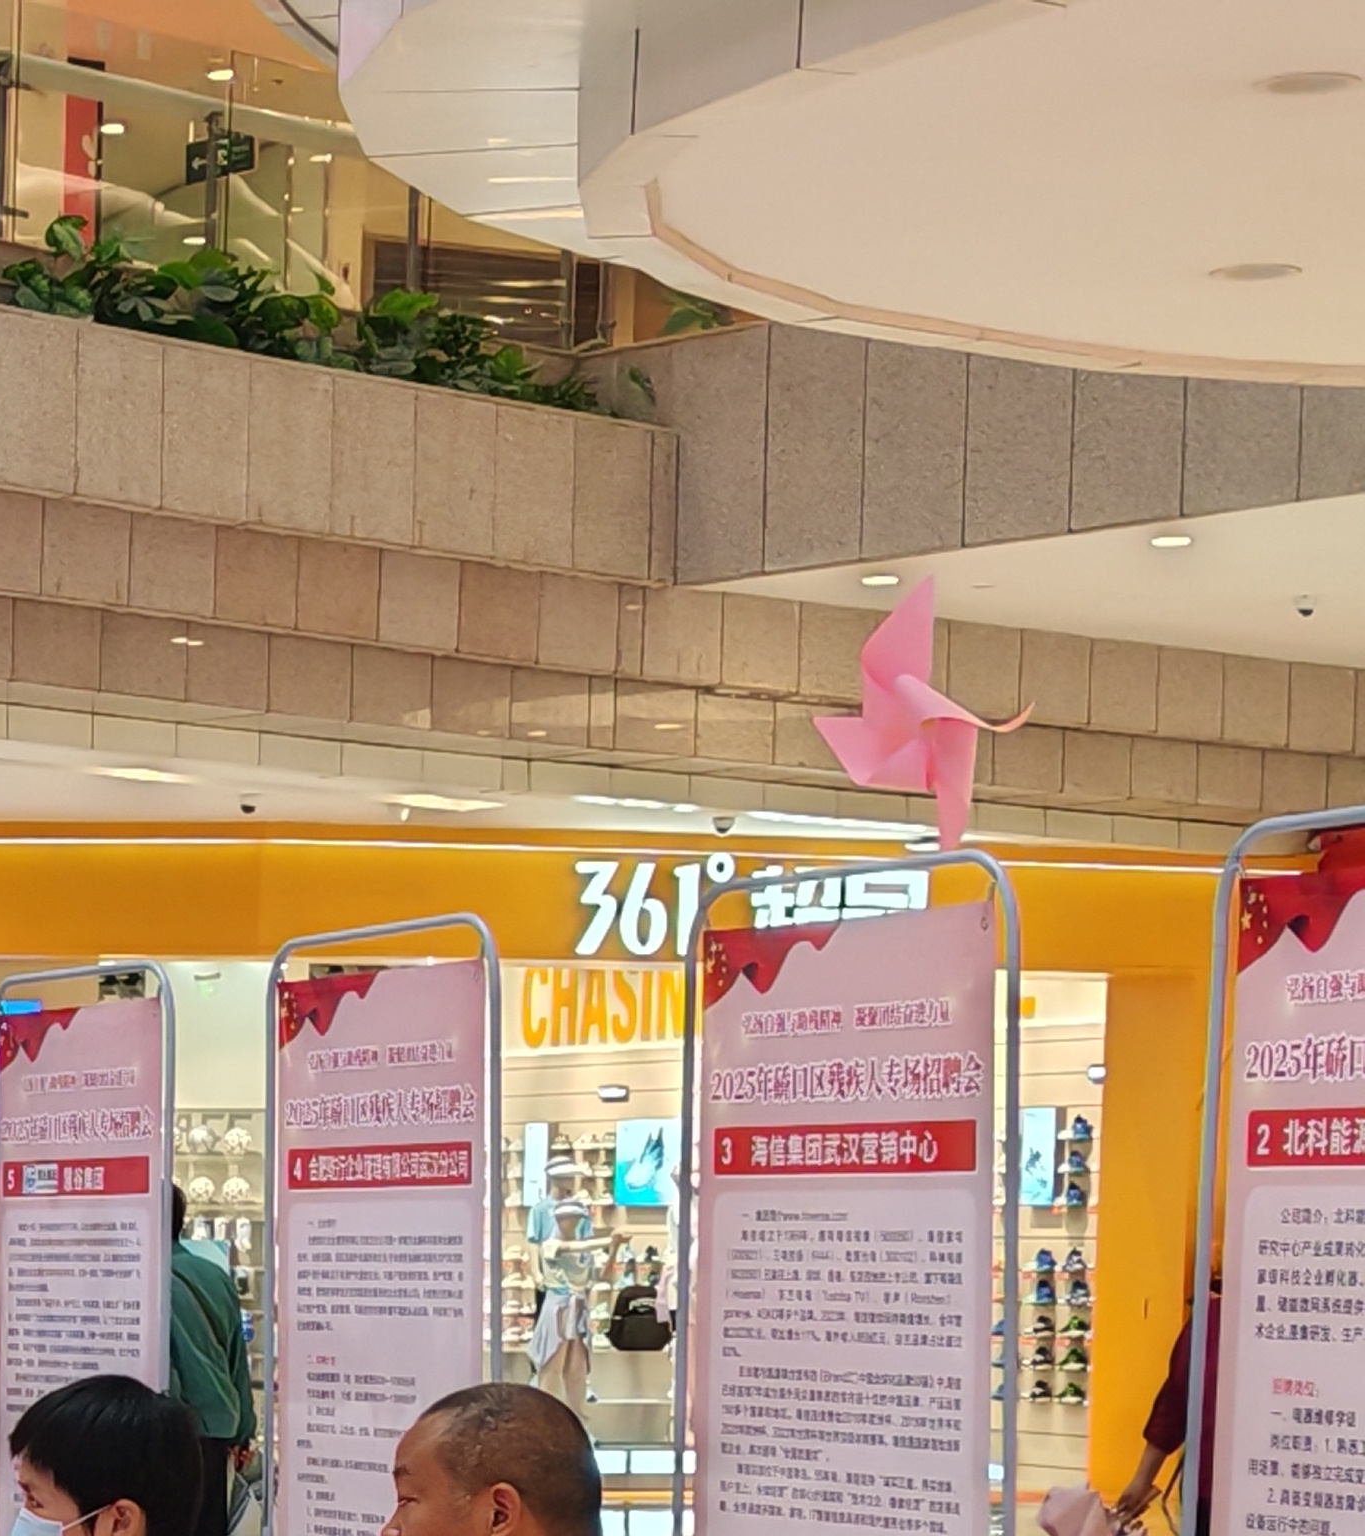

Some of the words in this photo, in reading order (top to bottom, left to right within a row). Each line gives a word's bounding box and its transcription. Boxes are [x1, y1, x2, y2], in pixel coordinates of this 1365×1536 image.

[721, 1137, 732, 1165] 3
[751, 1130, 938, 1167] 海信集团武汉营销中心
[1256, 1123, 1271, 1156] 2
[8, 1169, 15, 1191] 5
[293, 1157, 302, 1181] 4
